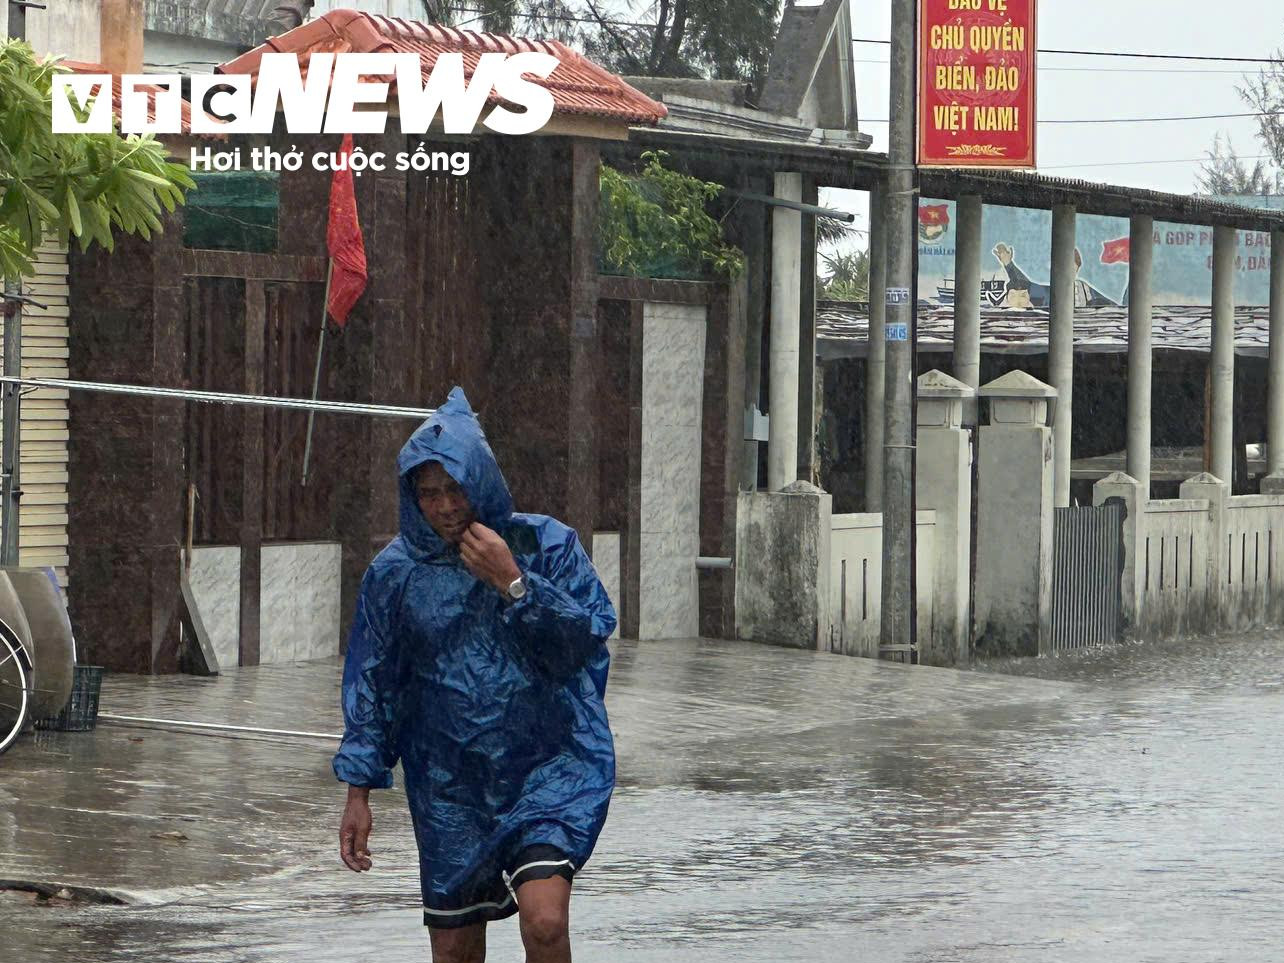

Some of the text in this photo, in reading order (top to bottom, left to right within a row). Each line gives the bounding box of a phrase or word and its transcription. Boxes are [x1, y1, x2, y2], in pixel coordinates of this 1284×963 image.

[930, 18, 965, 50] CHỦ
[935, 56, 1020, 94] BIỂN, ĐẢO
[933, 101, 1019, 136] VIỆT NAM!
